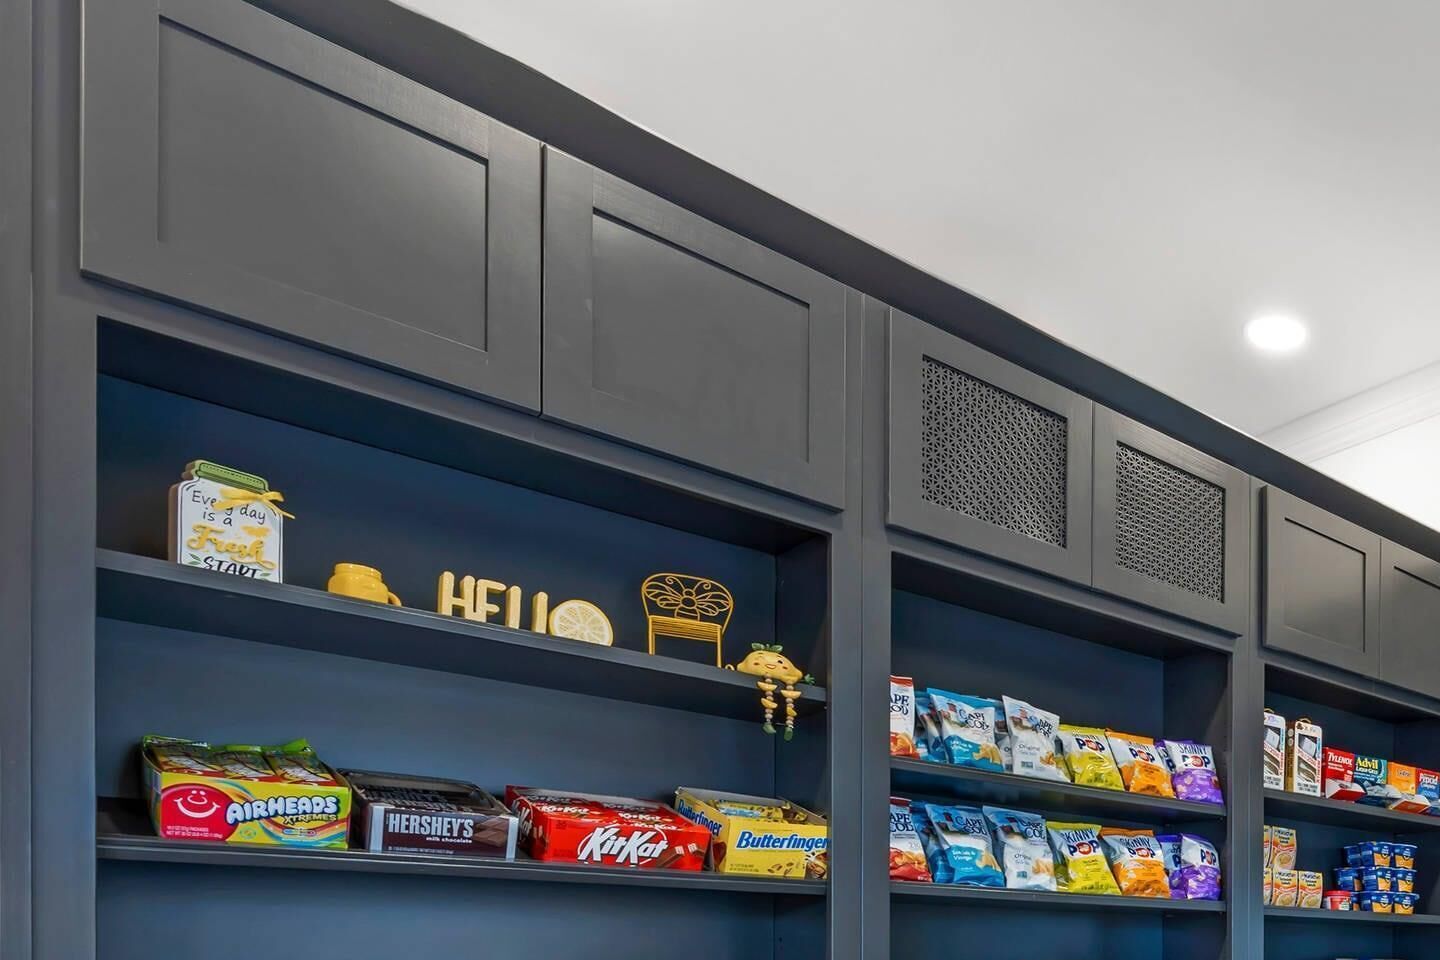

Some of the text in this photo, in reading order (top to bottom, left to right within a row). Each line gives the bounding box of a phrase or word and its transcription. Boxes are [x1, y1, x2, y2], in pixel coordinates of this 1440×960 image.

[203, 507, 232, 527] is a
[240, 504, 266, 525] day
[187, 524, 276, 570] Fresh
[1076, 738, 1105, 752] POP
[1129, 747, 1155, 763] POP
[1356, 757, 1378, 769] Advil
[227, 796, 338, 824] AIRHEADS
[283, 814, 337, 824] XTREMES
[388, 813, 474, 838] HERSHEY'S
[955, 815, 983, 830] CAPE
[963, 826, 988, 836] COD
[1062, 828, 1095, 843] SKINNY
[736, 830, 832, 852] Butterfinger
[1067, 840, 1100, 856] POP
[1128, 847, 1156, 859] POP
[1200, 849, 1217, 866] POP
